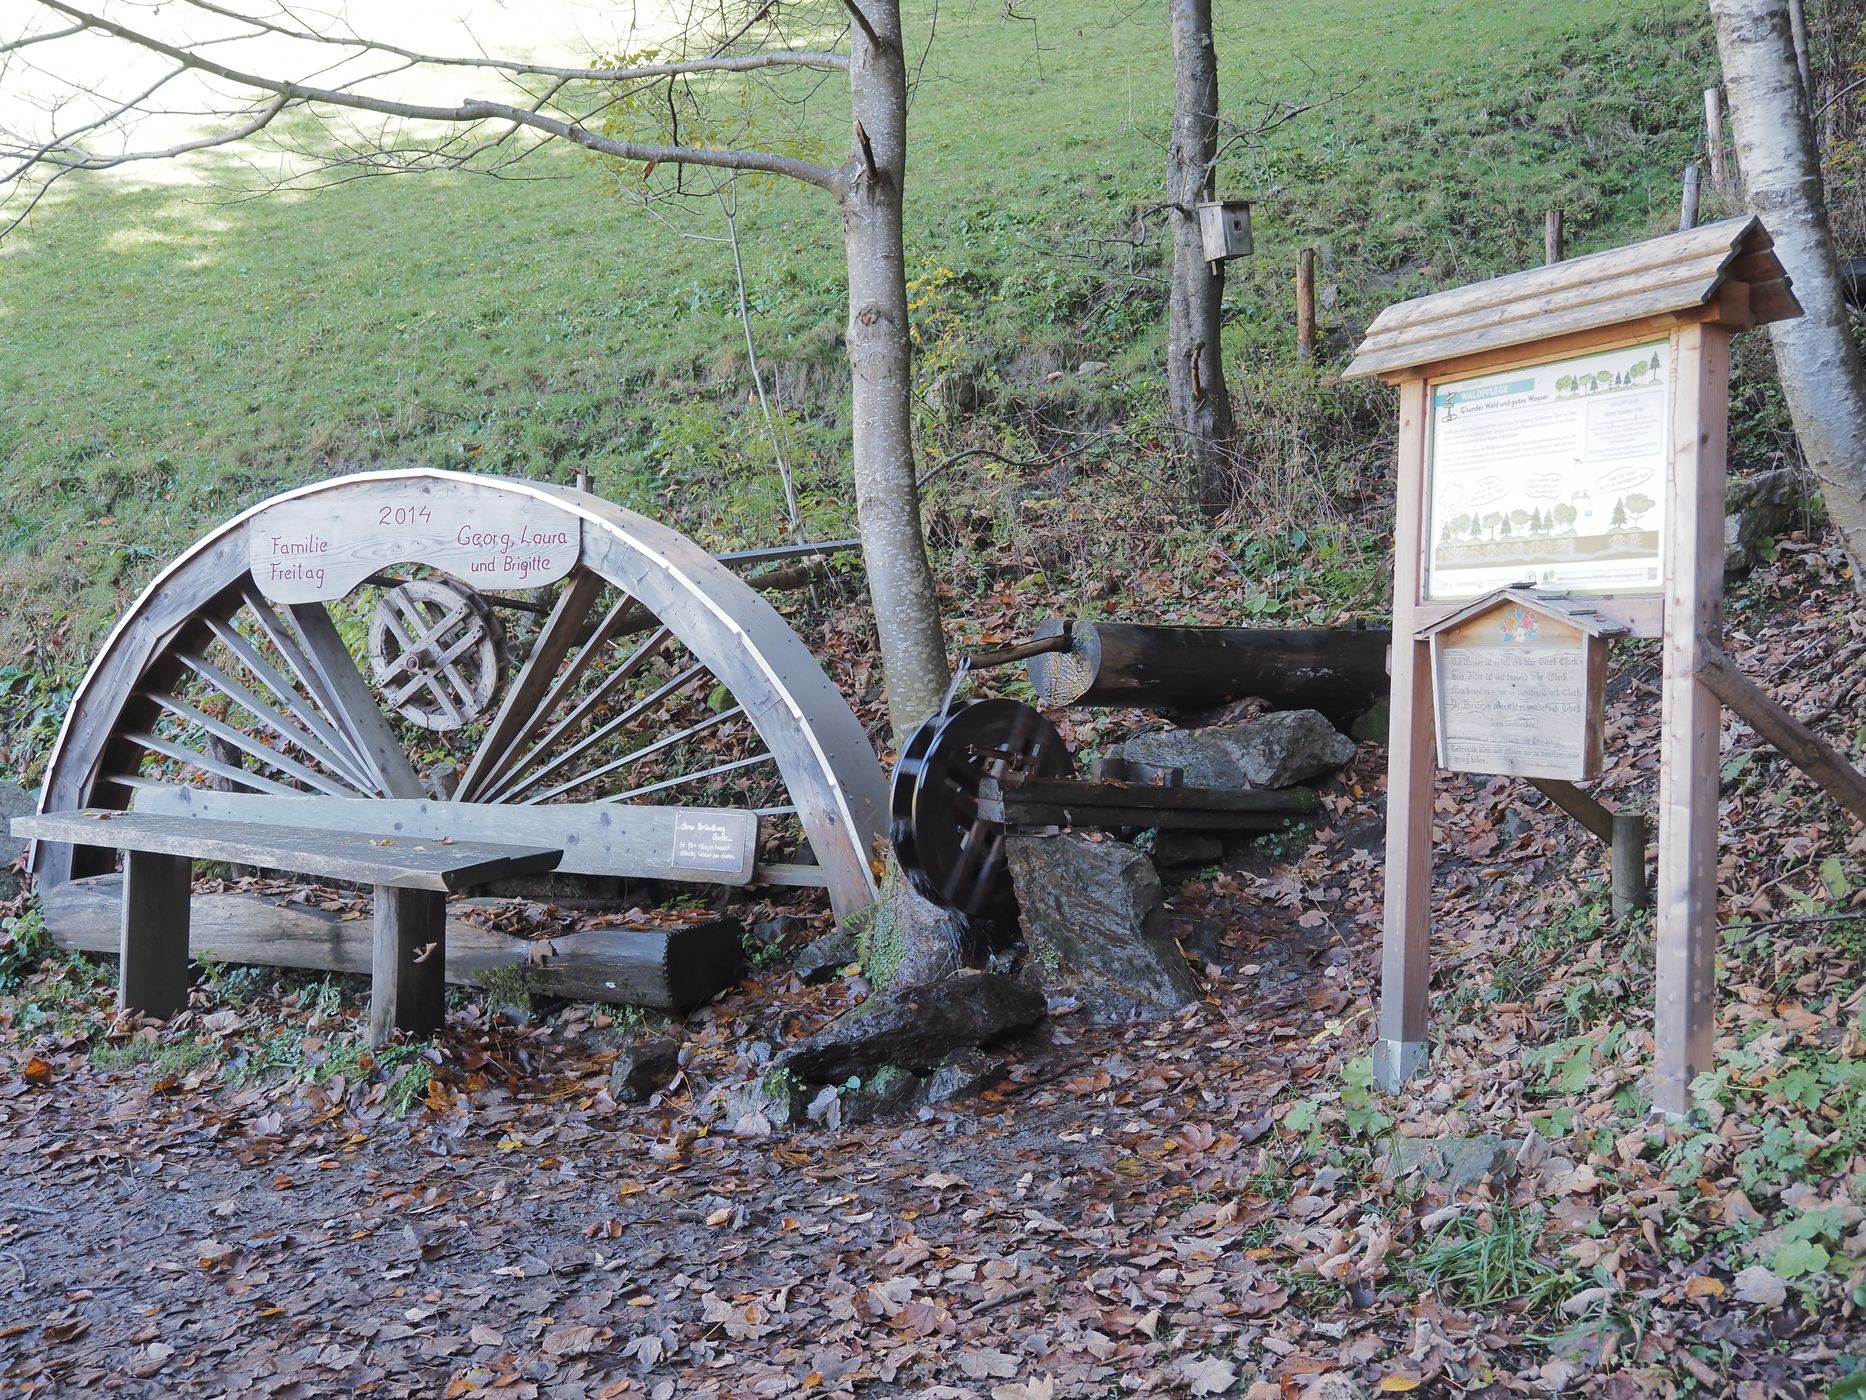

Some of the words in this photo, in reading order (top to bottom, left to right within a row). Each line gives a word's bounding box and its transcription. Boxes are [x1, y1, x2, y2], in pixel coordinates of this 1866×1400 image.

[1461, 384, 1509, 401] WALDPFLEGE
[1485, 400, 1499, 410] Wald
[1500, 398, 1511, 407] und
[1511, 396, 1527, 408] gutes
[1528, 392, 1549, 403] Wasser
[378, 505, 432, 526] 2014
[271, 533, 328, 555] Familie
[456, 524, 515, 554] Georg,
[520, 525, 568, 545] Laura
[269, 561, 325, 589] Freitag
[470, 557, 496, 573] und
[503, 556, 551, 580] Brigitte
